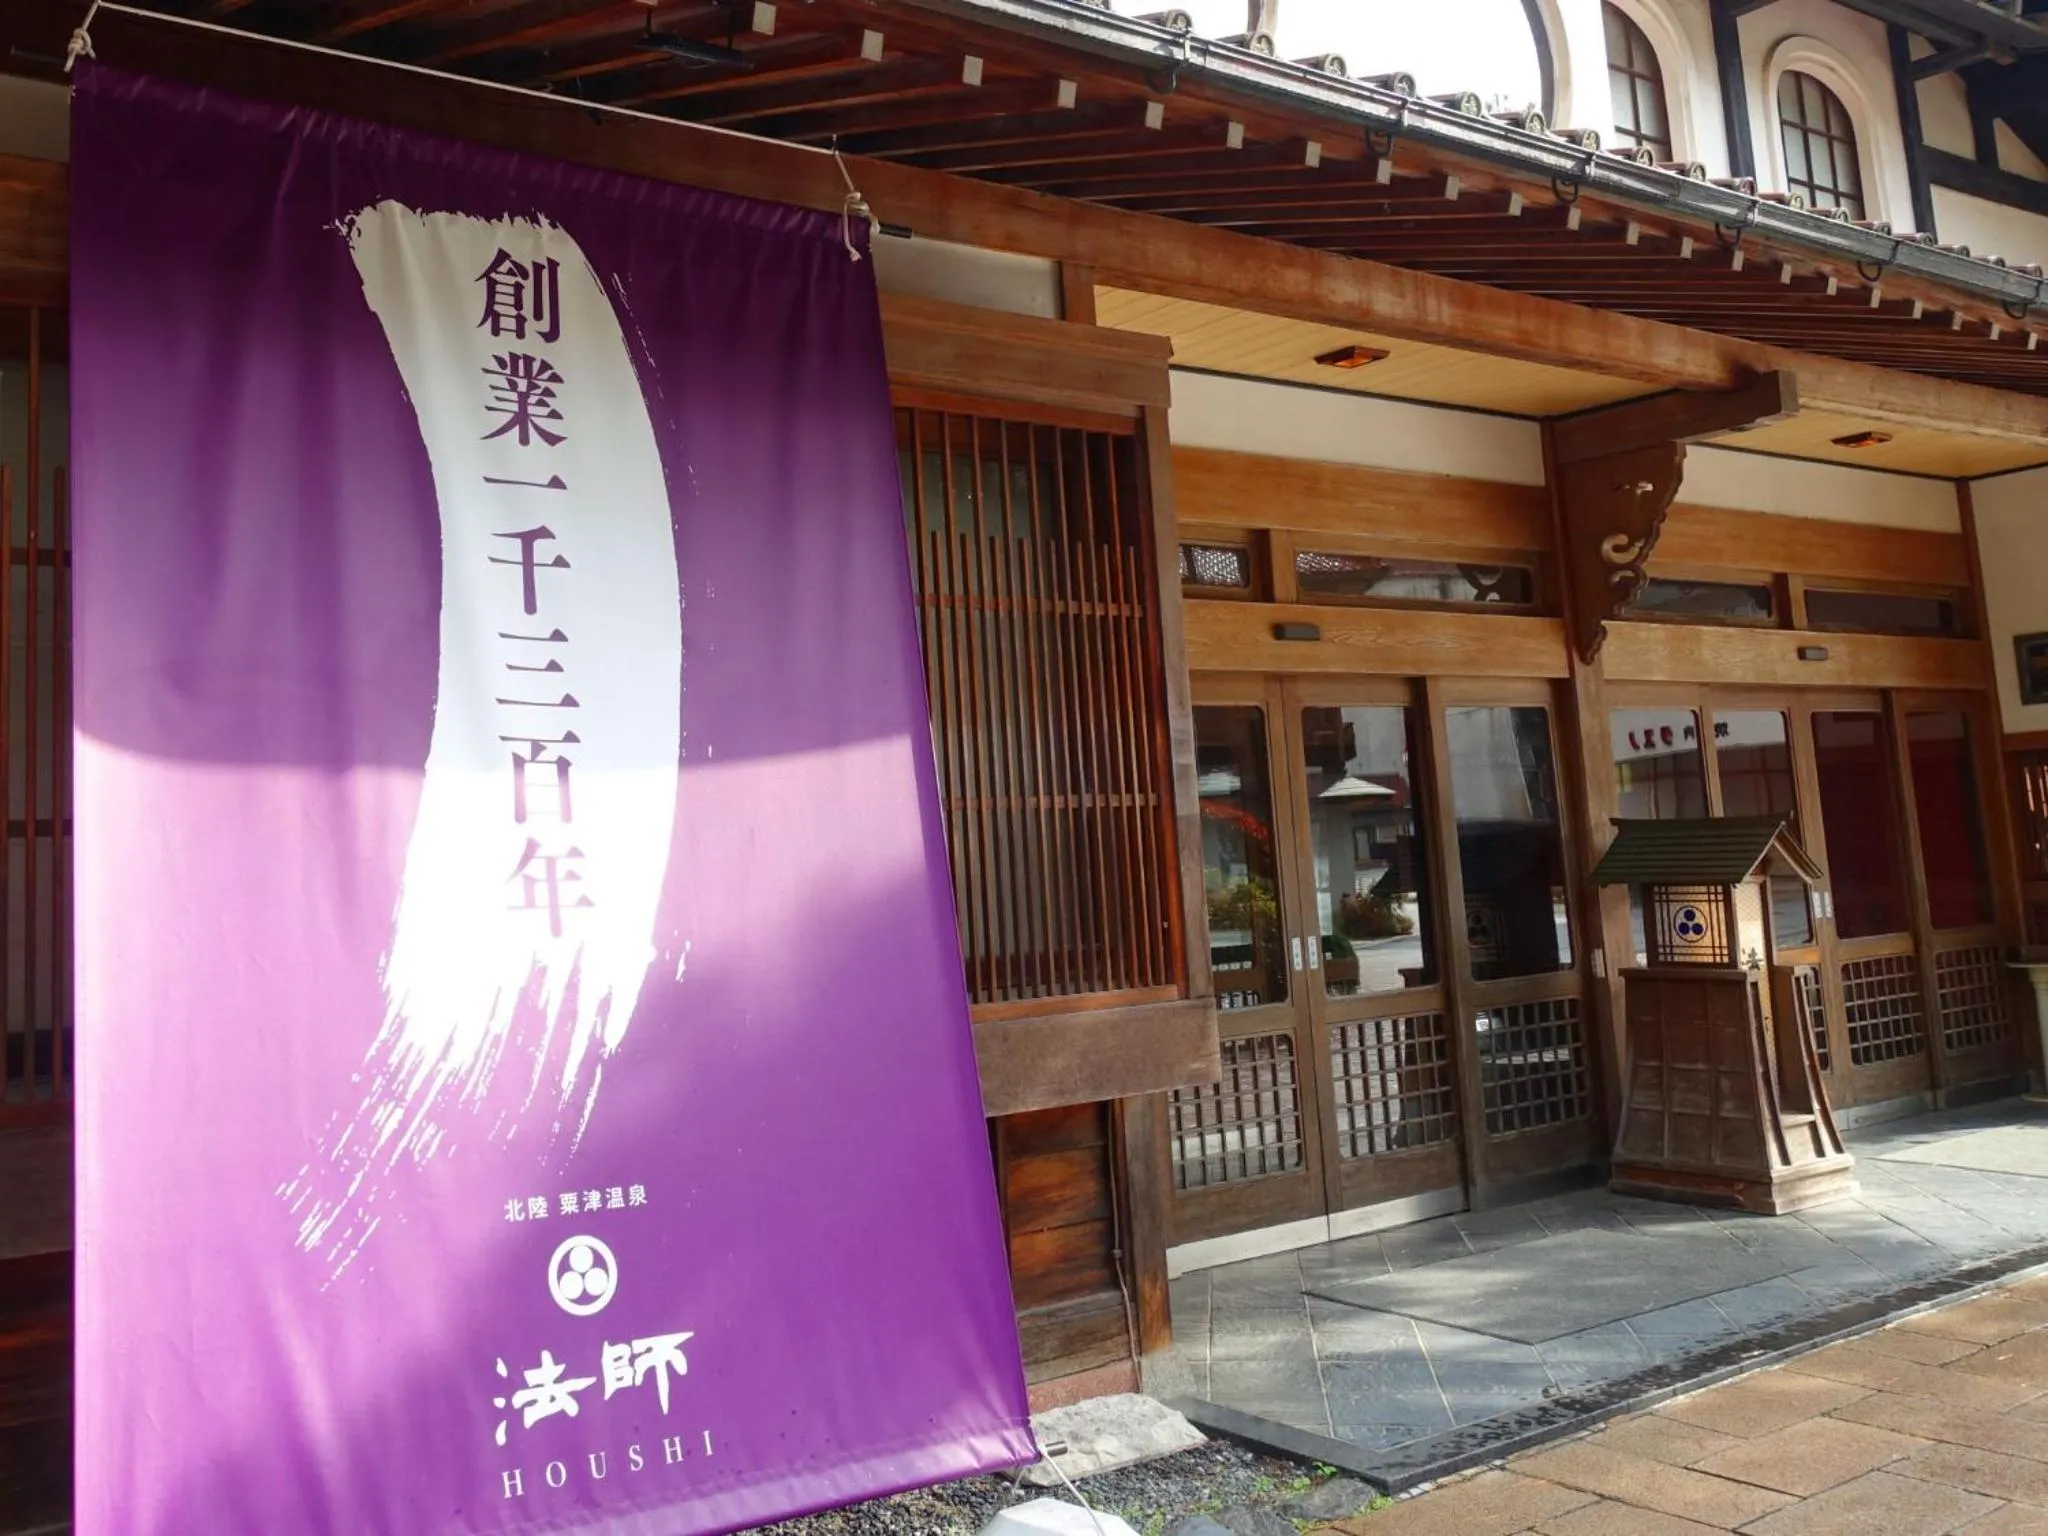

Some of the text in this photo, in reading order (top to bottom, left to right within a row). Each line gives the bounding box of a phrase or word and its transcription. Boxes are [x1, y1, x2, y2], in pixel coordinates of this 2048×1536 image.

[474, 247, 595, 938] 創業一千三百年
[504, 1184, 648, 1222] 北陸 粟津温泉
[493, 1331, 694, 1446] 法師
[502, 1430, 714, 1498] HOUSHI
